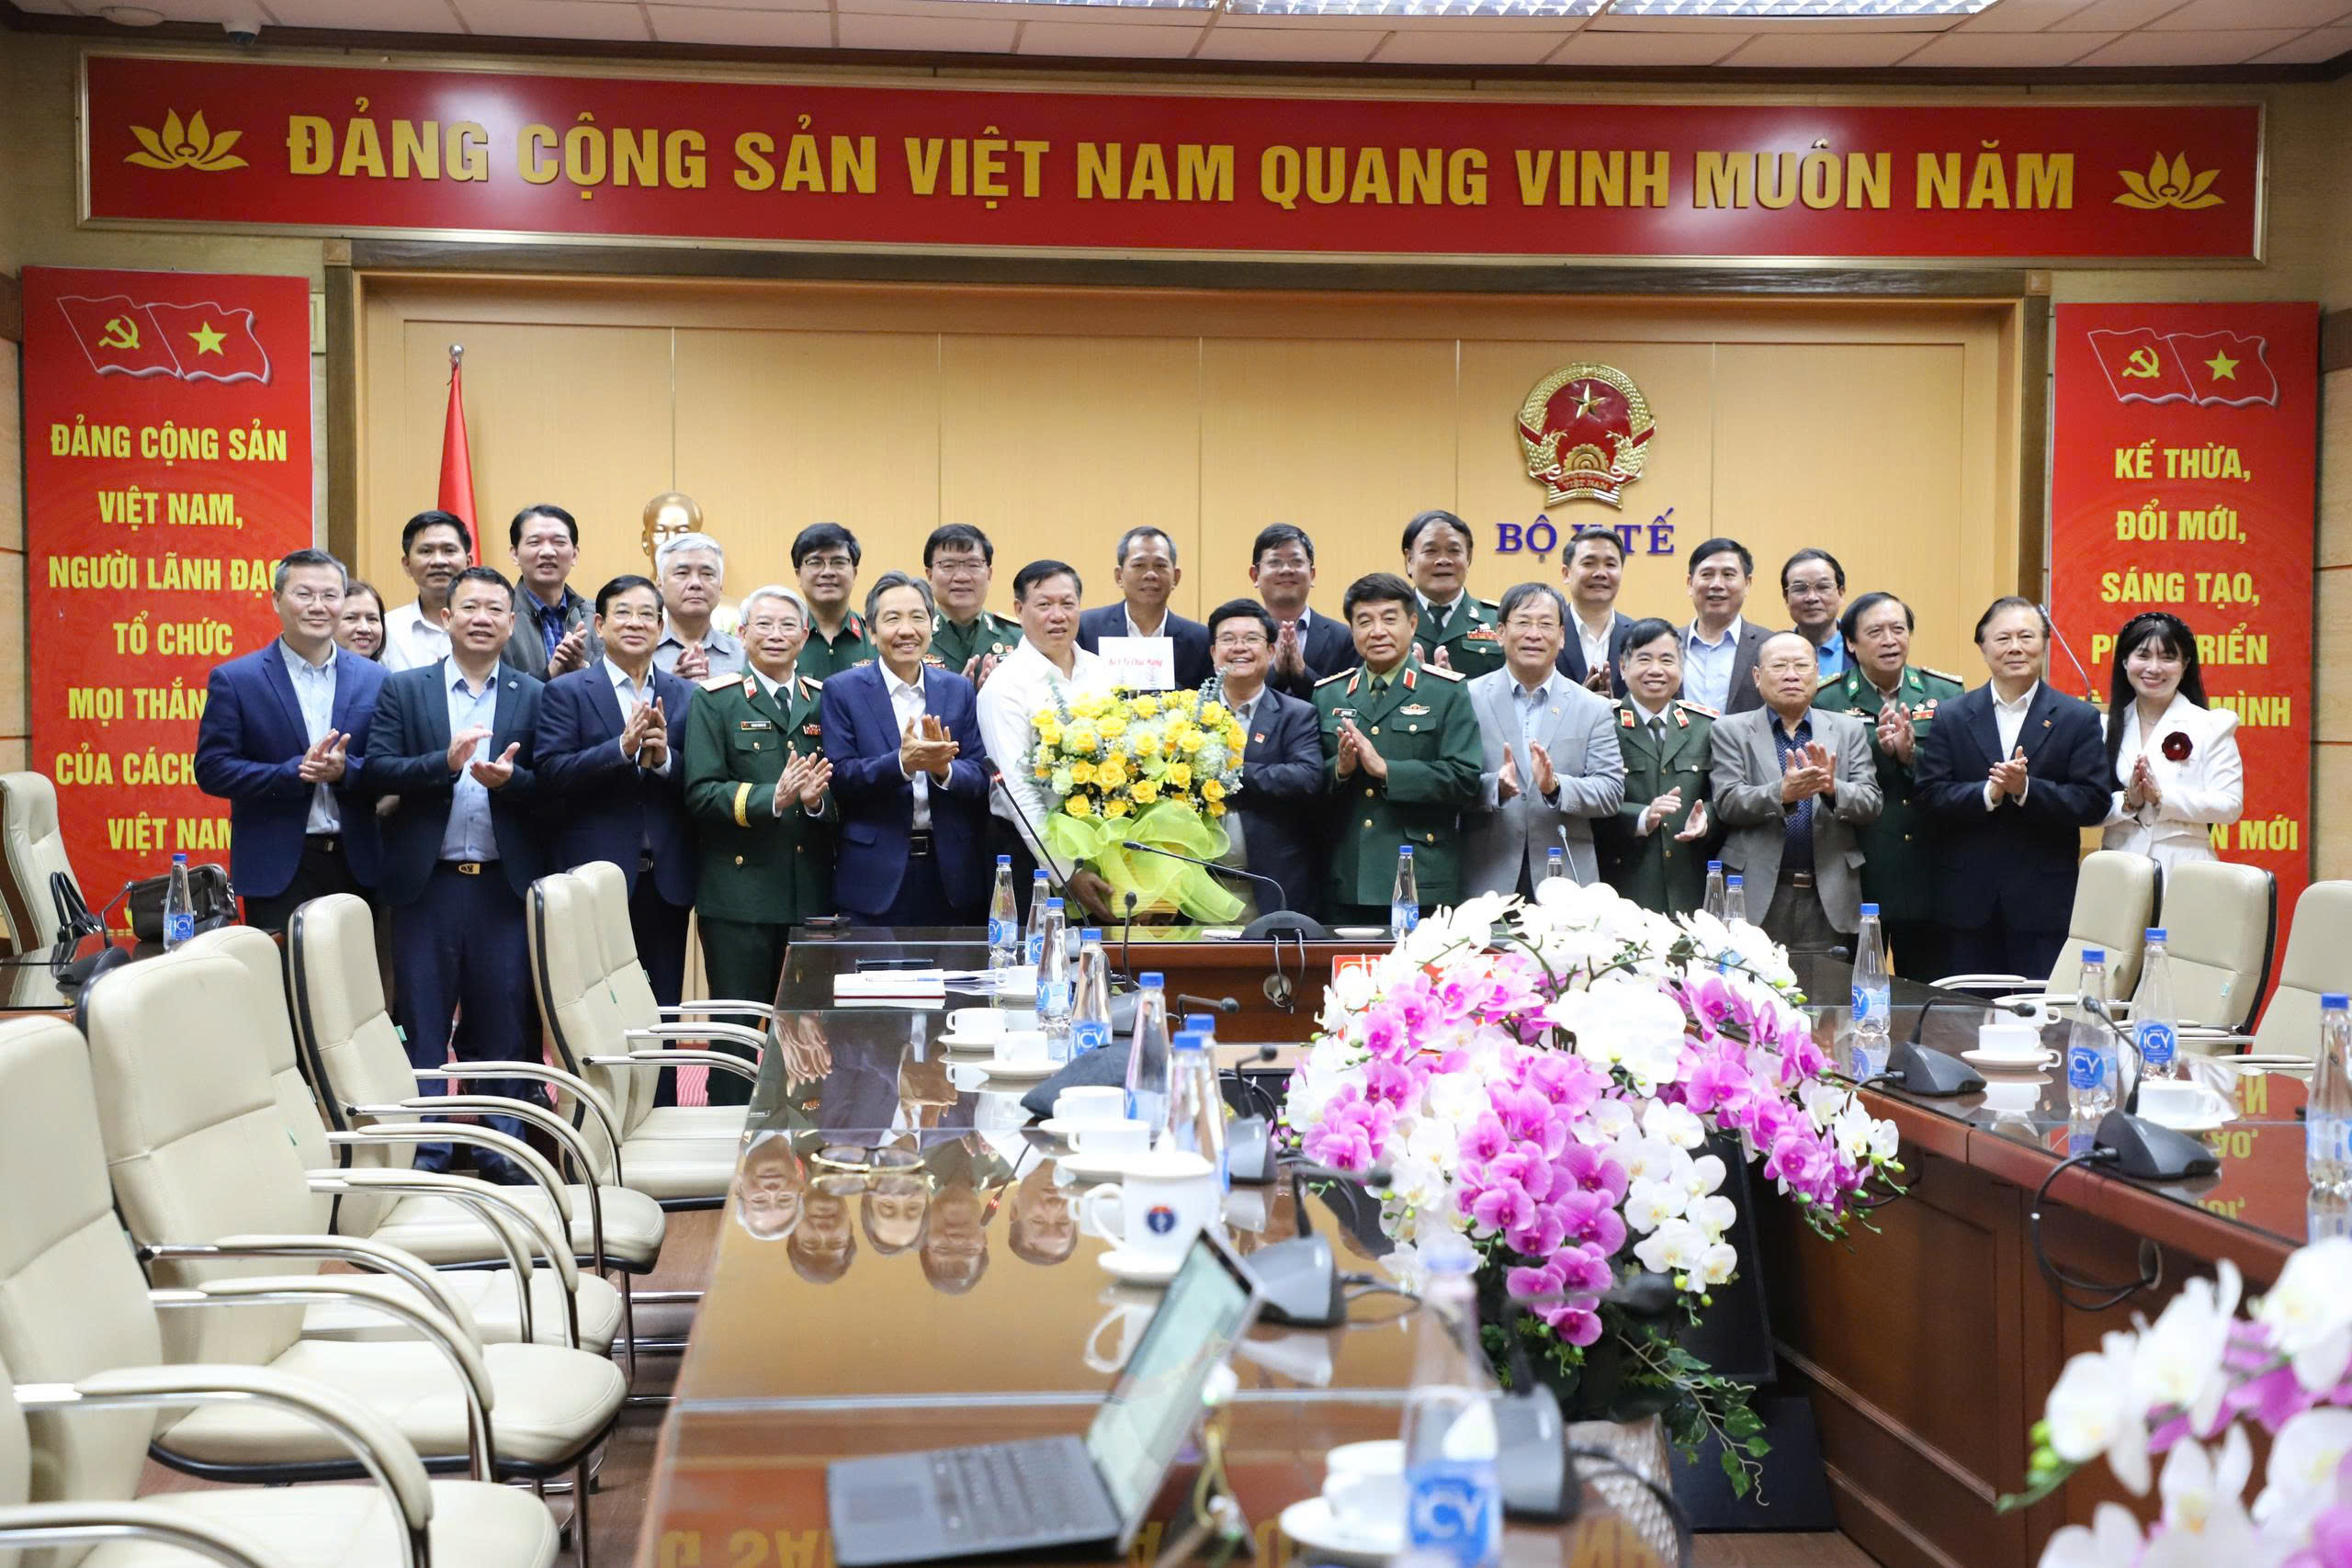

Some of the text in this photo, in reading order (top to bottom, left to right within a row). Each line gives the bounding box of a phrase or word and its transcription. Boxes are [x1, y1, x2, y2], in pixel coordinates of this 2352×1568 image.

[286, 96, 2075, 210] ĐẢNG CỘNG SẢN VIỆT NAM QUANG VINH MUÔN NĂM
[51, 414, 288, 467] ĐẢNG CỘNG SẢN
[2115, 438, 2251, 482] KẾ THỪA,
[97, 485, 243, 531] VIỆT NAM,
[2116, 499, 2246, 545] ĐỔI MỚI,
[1496, 507, 1675, 563] BỘ TẾ
[49, 549, 138, 589] NGƯỜI
[147, 552, 221, 591] LÃNH
[2101, 566, 2260, 609] SÁNG TẠO,
[112, 610, 234, 657] TỔ CHỨC
[2193, 622, 2268, 665] RIỂN
[68, 676, 208, 727] MỌI THẮN
[55, 742, 197, 785] CỦA CÁCH
[107, 812, 232, 856] VIỆT NAM
[2239, 814, 2299, 851] MỚI
[1077, 1030, 1104, 1049] ICY
[2143, 1032, 2170, 1049] ICY
[2070, 1054, 2099, 1075] ICY
